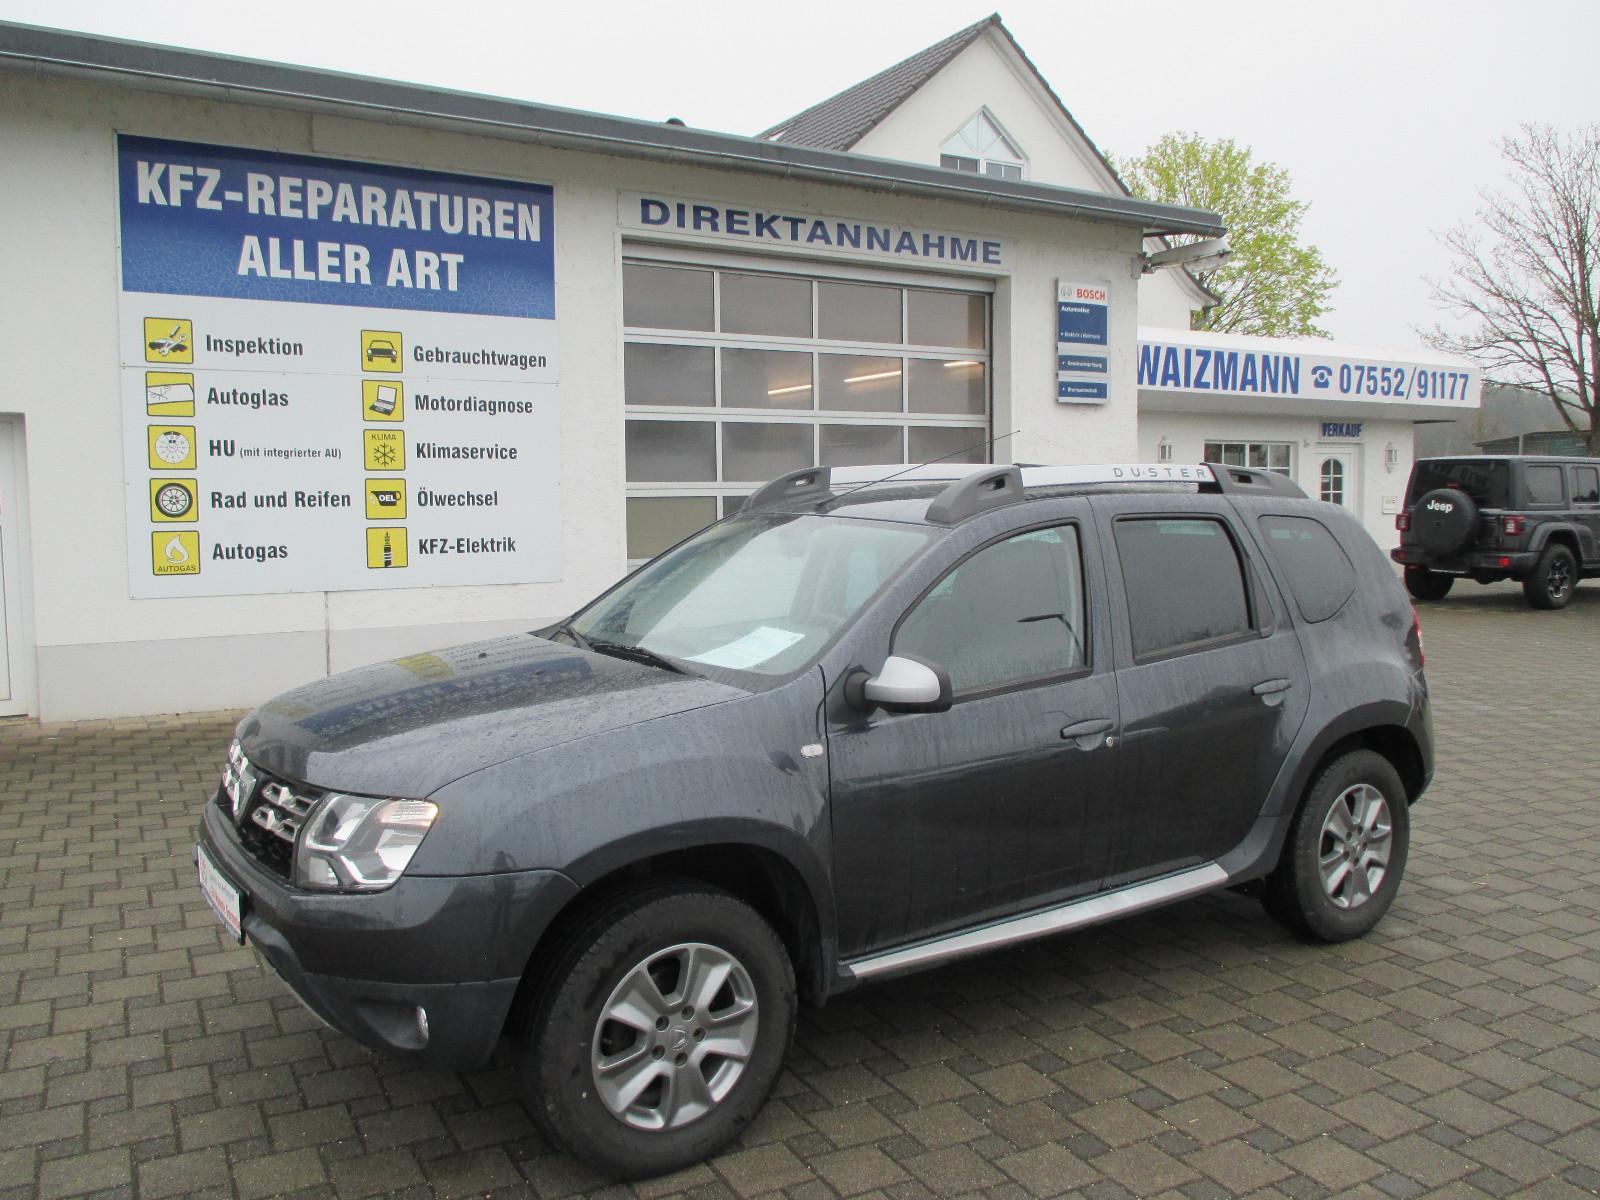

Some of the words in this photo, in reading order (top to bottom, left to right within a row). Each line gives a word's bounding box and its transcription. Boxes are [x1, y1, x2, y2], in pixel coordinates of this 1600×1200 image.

[136, 160, 541, 243] KFZ-REPARATUREN
[640, 198, 1002, 265] DIREKTANNAHME
[237, 235, 371, 285] ALLER
[386, 248, 464, 292] ART
[1076, 288, 1105, 301] BOSCH
[206, 334, 303, 357] Inspektion
[413, 345, 547, 370] Gebrauchtwagen
[1137, 344, 1300, 395] WAIZMANN
[1338, 363, 1469, 401] 07552/91177
[207, 387, 289, 409] Autoglas
[415, 394, 533, 416] Motordiagnose
[371, 433, 397, 441] KLIMA
[1321, 422, 1363, 438] VERKAUF
[209, 439, 236, 457] HU
[240, 447, 260, 460] (mit
[263, 447, 322, 460] integrierter
[325, 448, 342, 460] AU)
[416, 442, 518, 460] Klimaservice
[1113, 467, 1207, 478] DUSTER
[211, 491, 247, 508] Rad
[254, 491, 288, 508] und
[295, 489, 351, 508] Reifen
[378, 494, 395, 502] OEL
[417, 486, 498, 507] Ölwechsel
[1427, 500, 1453, 513] Jeep
[212, 543, 288, 562] Autogas
[418, 537, 516, 555] KFZ-Elektrik
[157, 564, 197, 572] AUTOGAS
